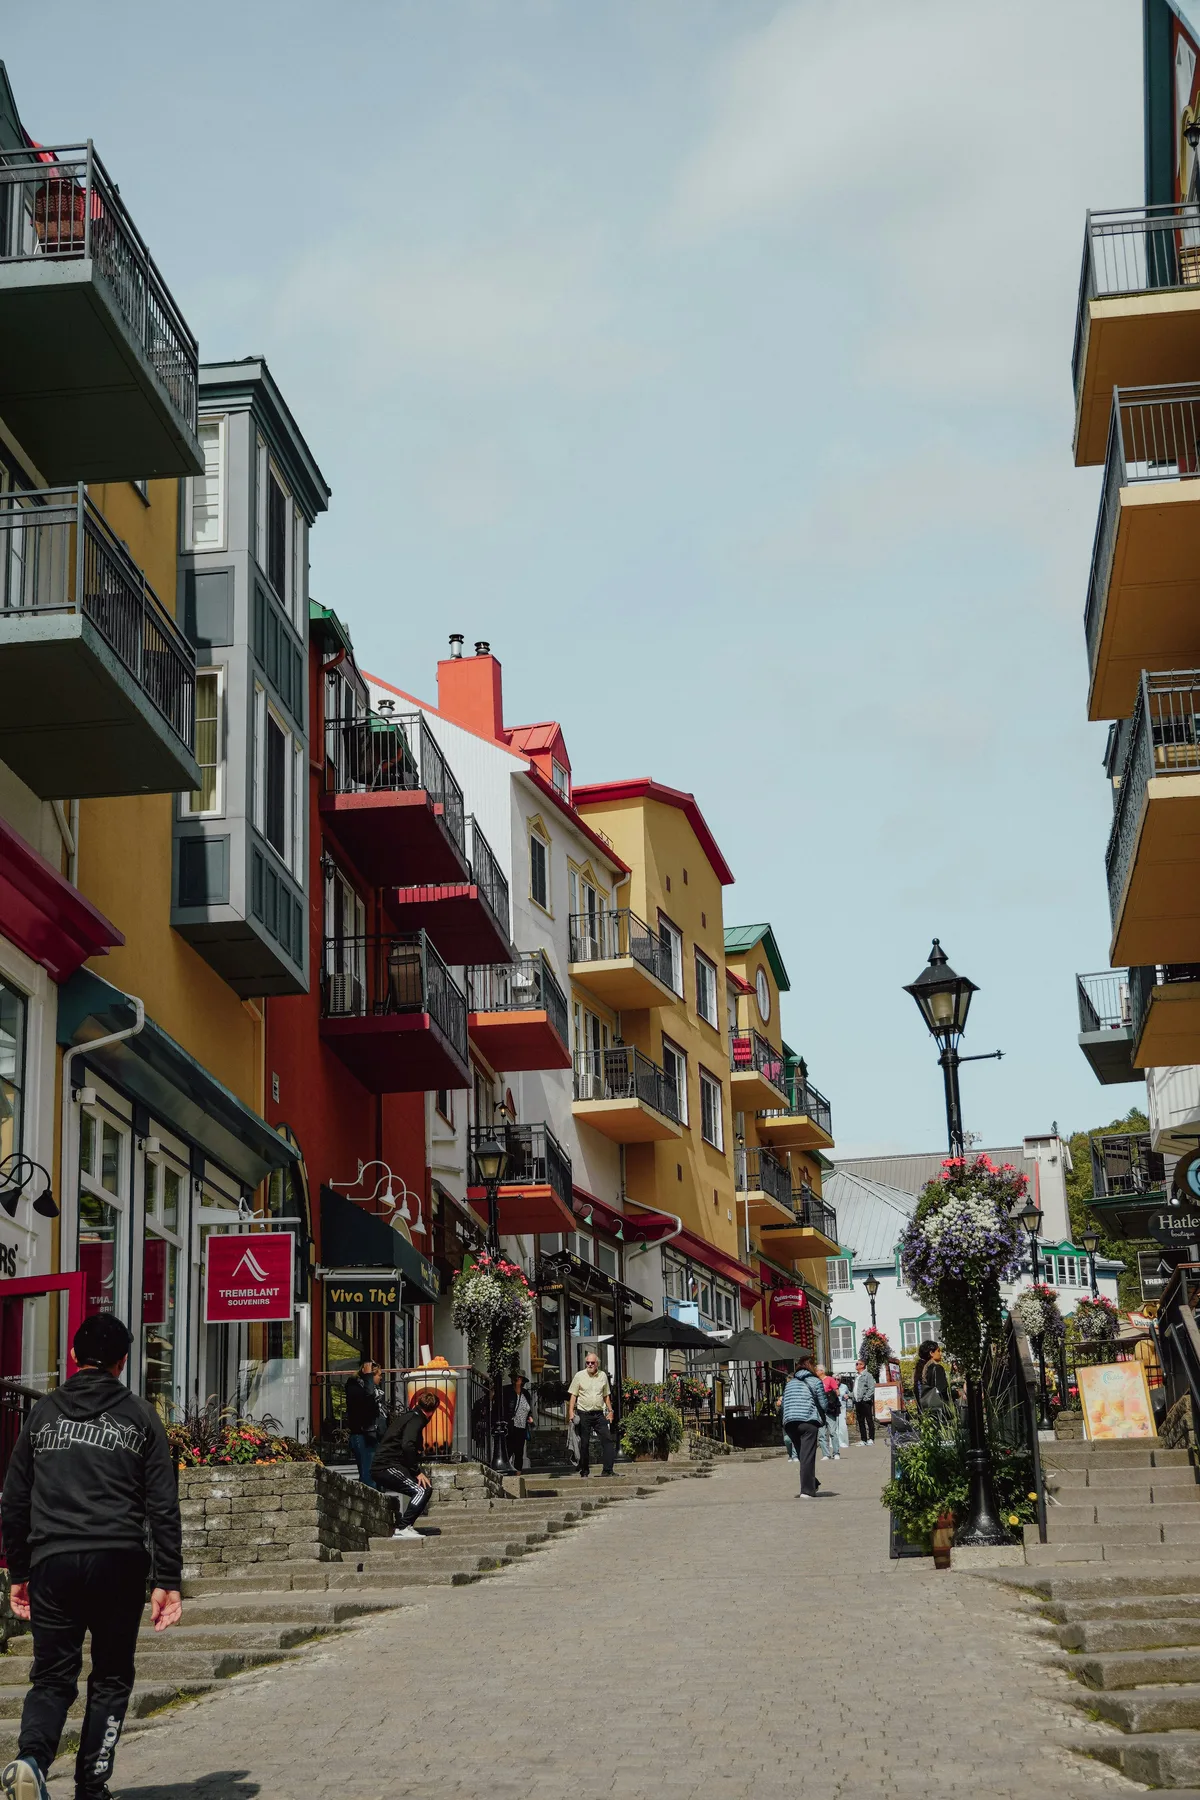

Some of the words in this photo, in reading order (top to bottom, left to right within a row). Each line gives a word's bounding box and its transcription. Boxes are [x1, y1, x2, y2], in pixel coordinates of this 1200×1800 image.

[1158, 1214, 1200, 1230] Hatle
[219, 1288, 280, 1298] TREMBLANT
[331, 1289, 363, 1303] Viva
[369, 1286, 396, 1306] Thé
[228, 1298, 270, 1306] SOUVENIRS
